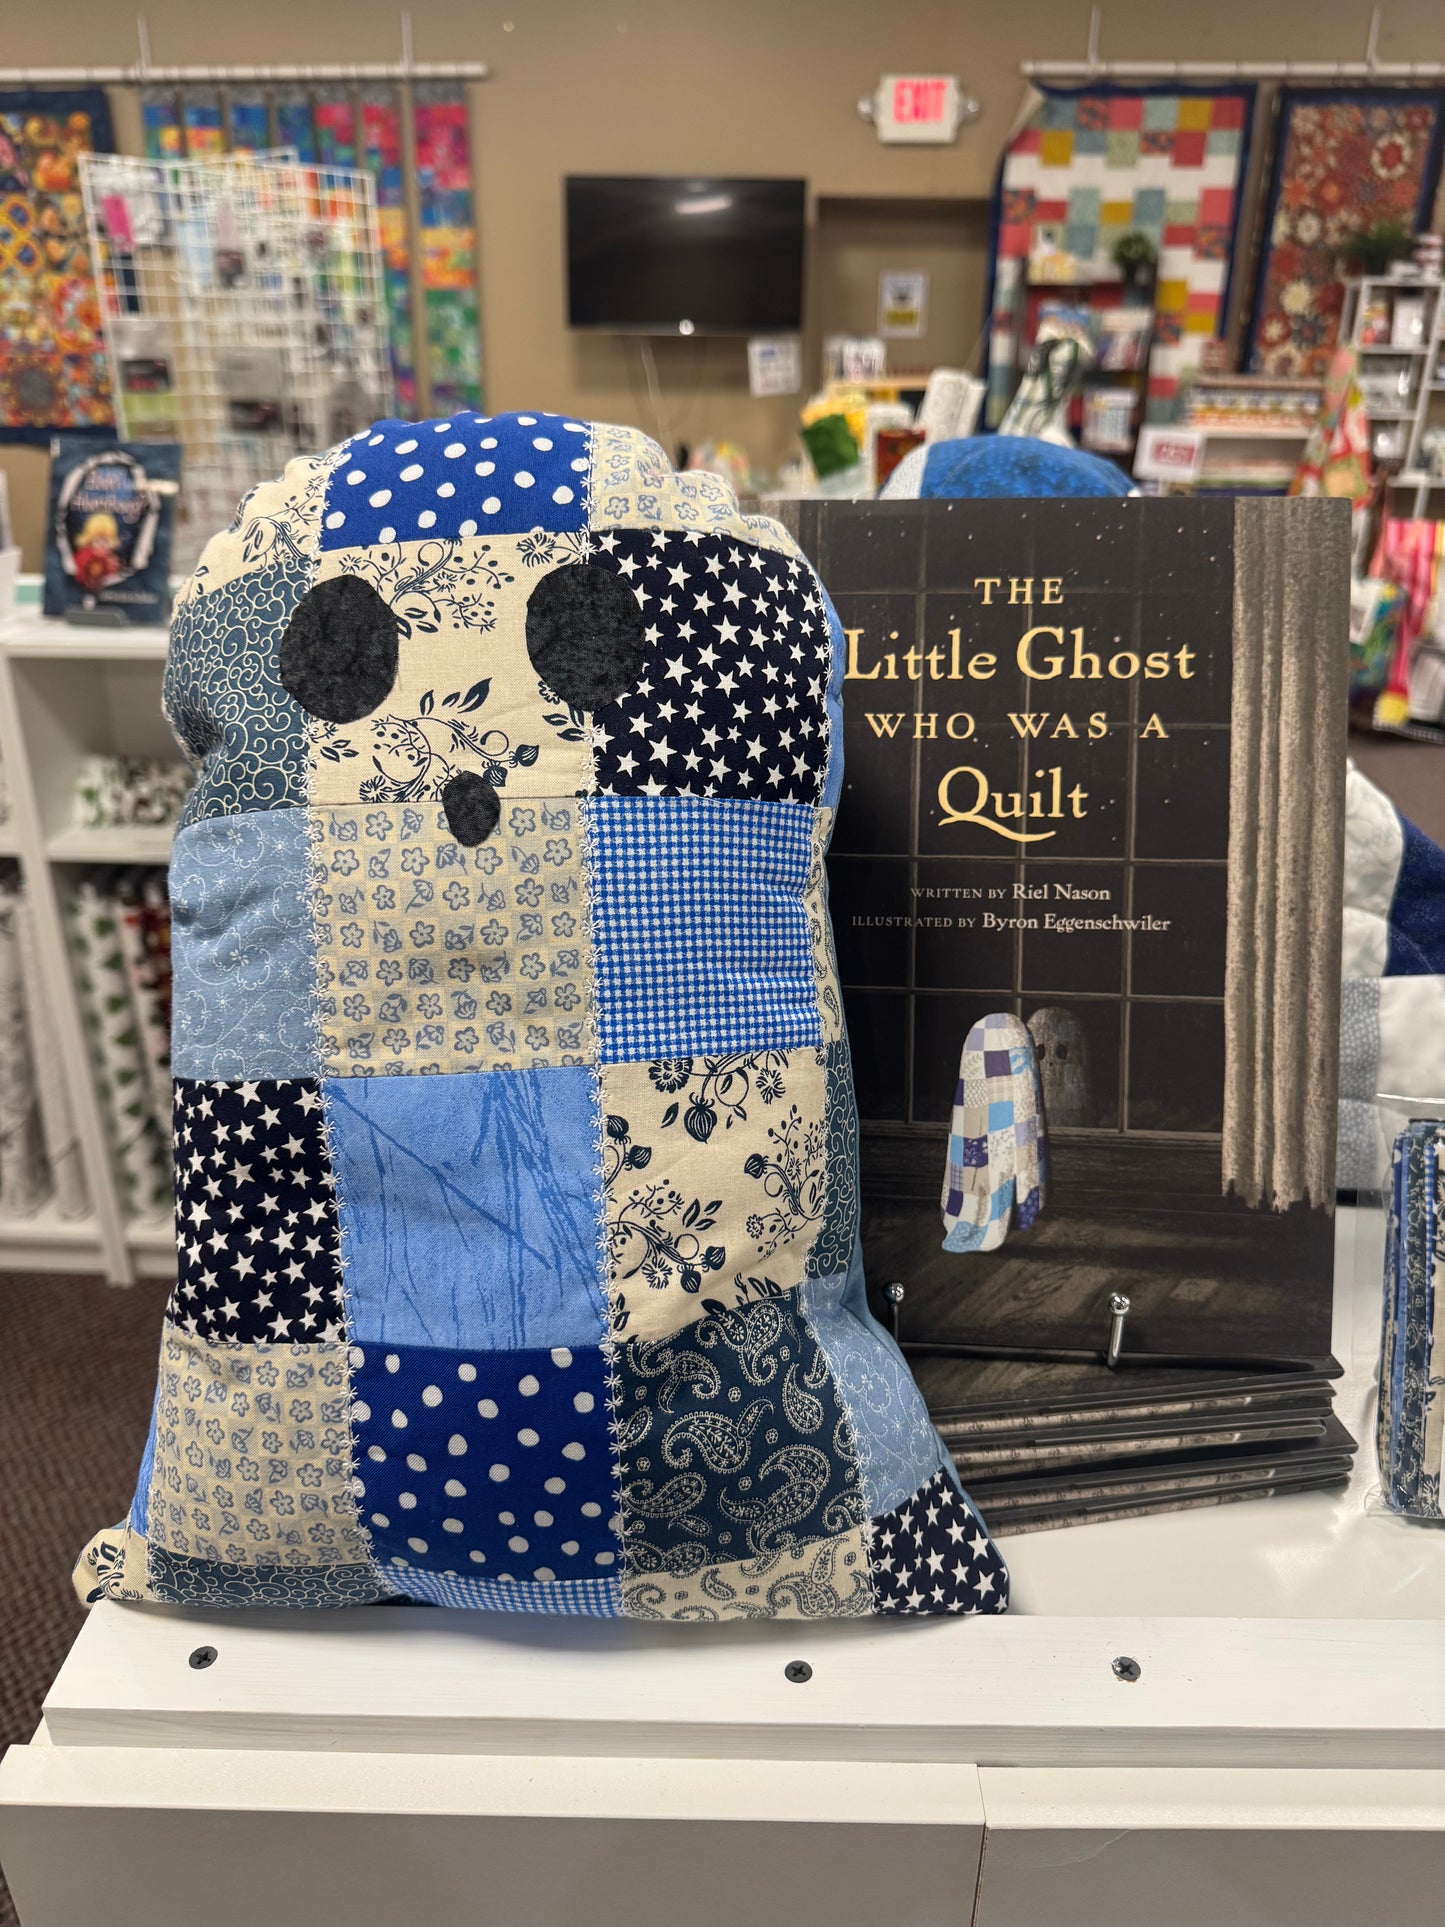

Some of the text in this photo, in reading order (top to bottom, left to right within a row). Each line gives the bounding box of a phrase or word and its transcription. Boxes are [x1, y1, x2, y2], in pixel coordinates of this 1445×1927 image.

[894, 78, 947, 123] EXIT
[974, 577, 1065, 606] THE
[845, 626, 1195, 681] Little Ghost
[865, 712, 1169, 740] WHO WAS A
[937, 766, 1089, 843] Quilt
[910, 883, 1111, 901] WRITTEN BY Riel Nason
[851, 912, 1172, 933] ILLUSTRATED BY Byron Eggenschwiler
